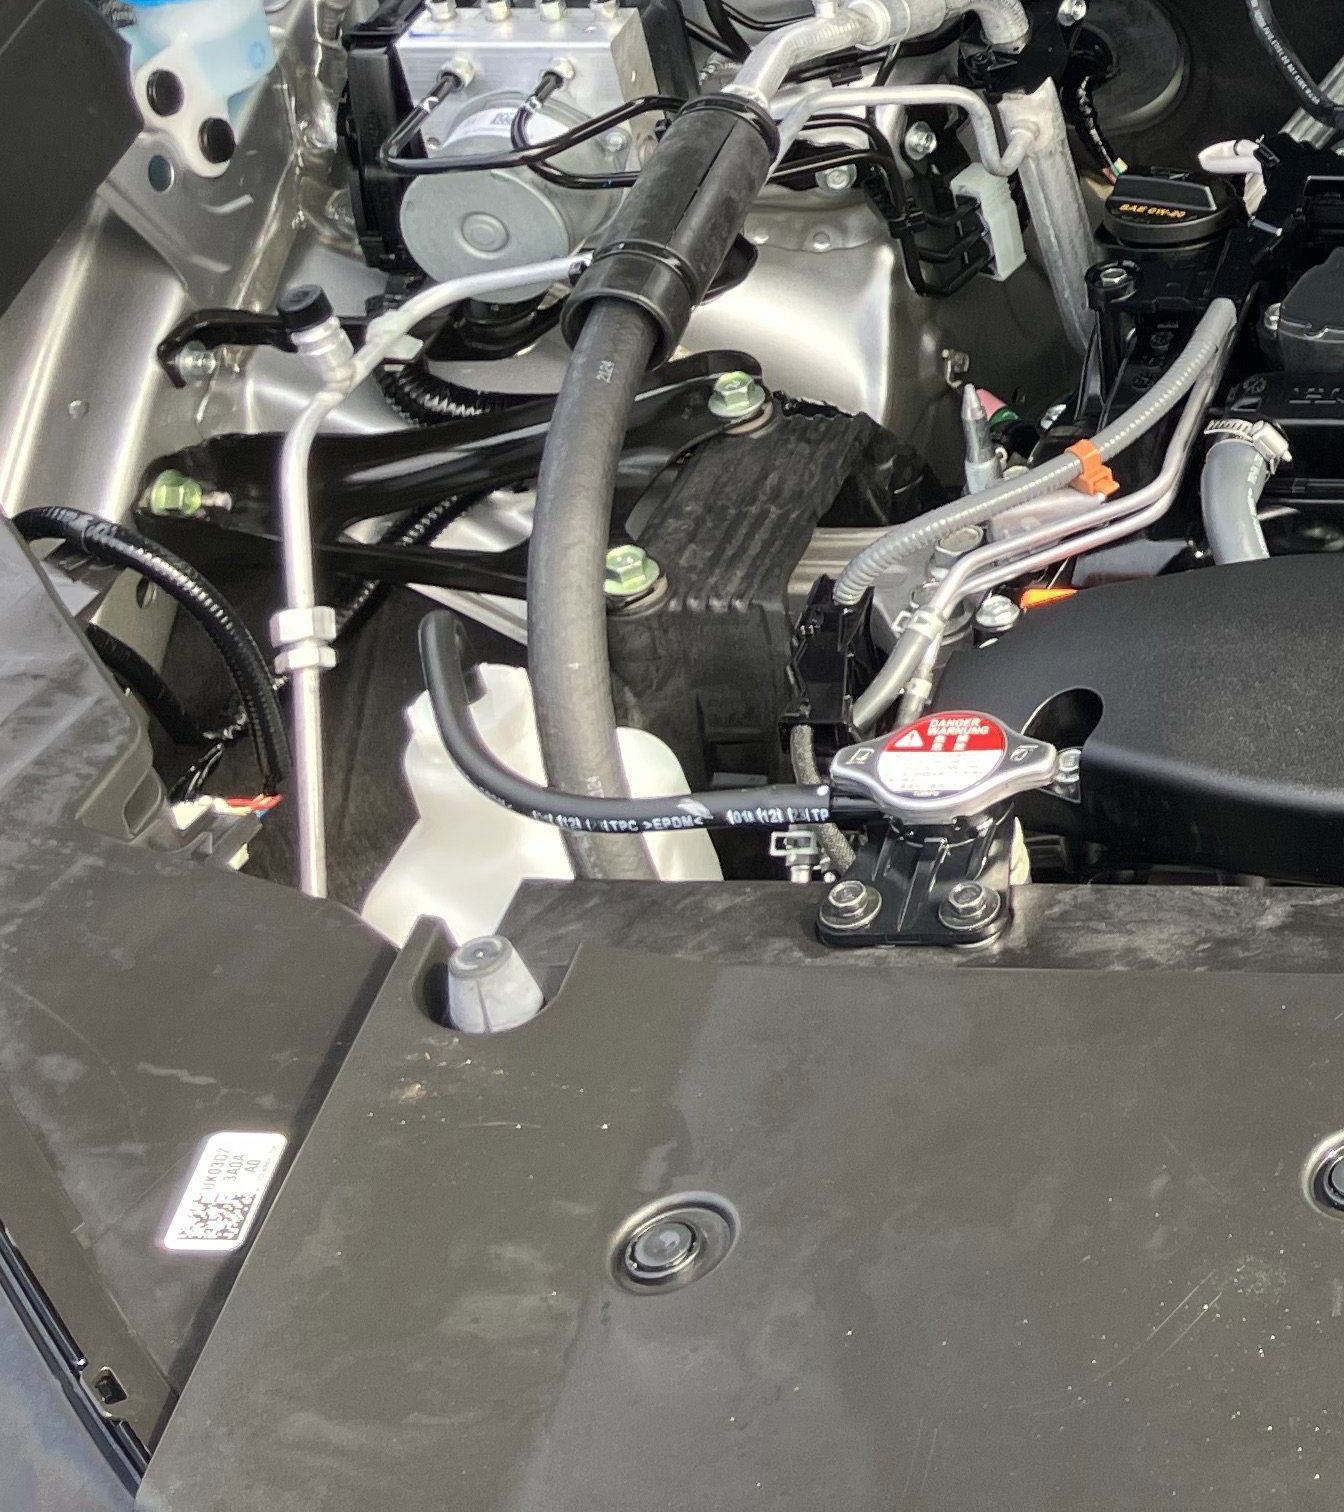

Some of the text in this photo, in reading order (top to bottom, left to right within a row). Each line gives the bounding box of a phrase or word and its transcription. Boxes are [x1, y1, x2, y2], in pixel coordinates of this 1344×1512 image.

[1119, 203, 1148, 213] SAE
[1147, 206, 1186, 219] 0W-20
[928, 717, 981, 727] DANGER
[926, 725, 990, 736] WARNUNG
[222, 1154, 246, 1182] 3A0A
